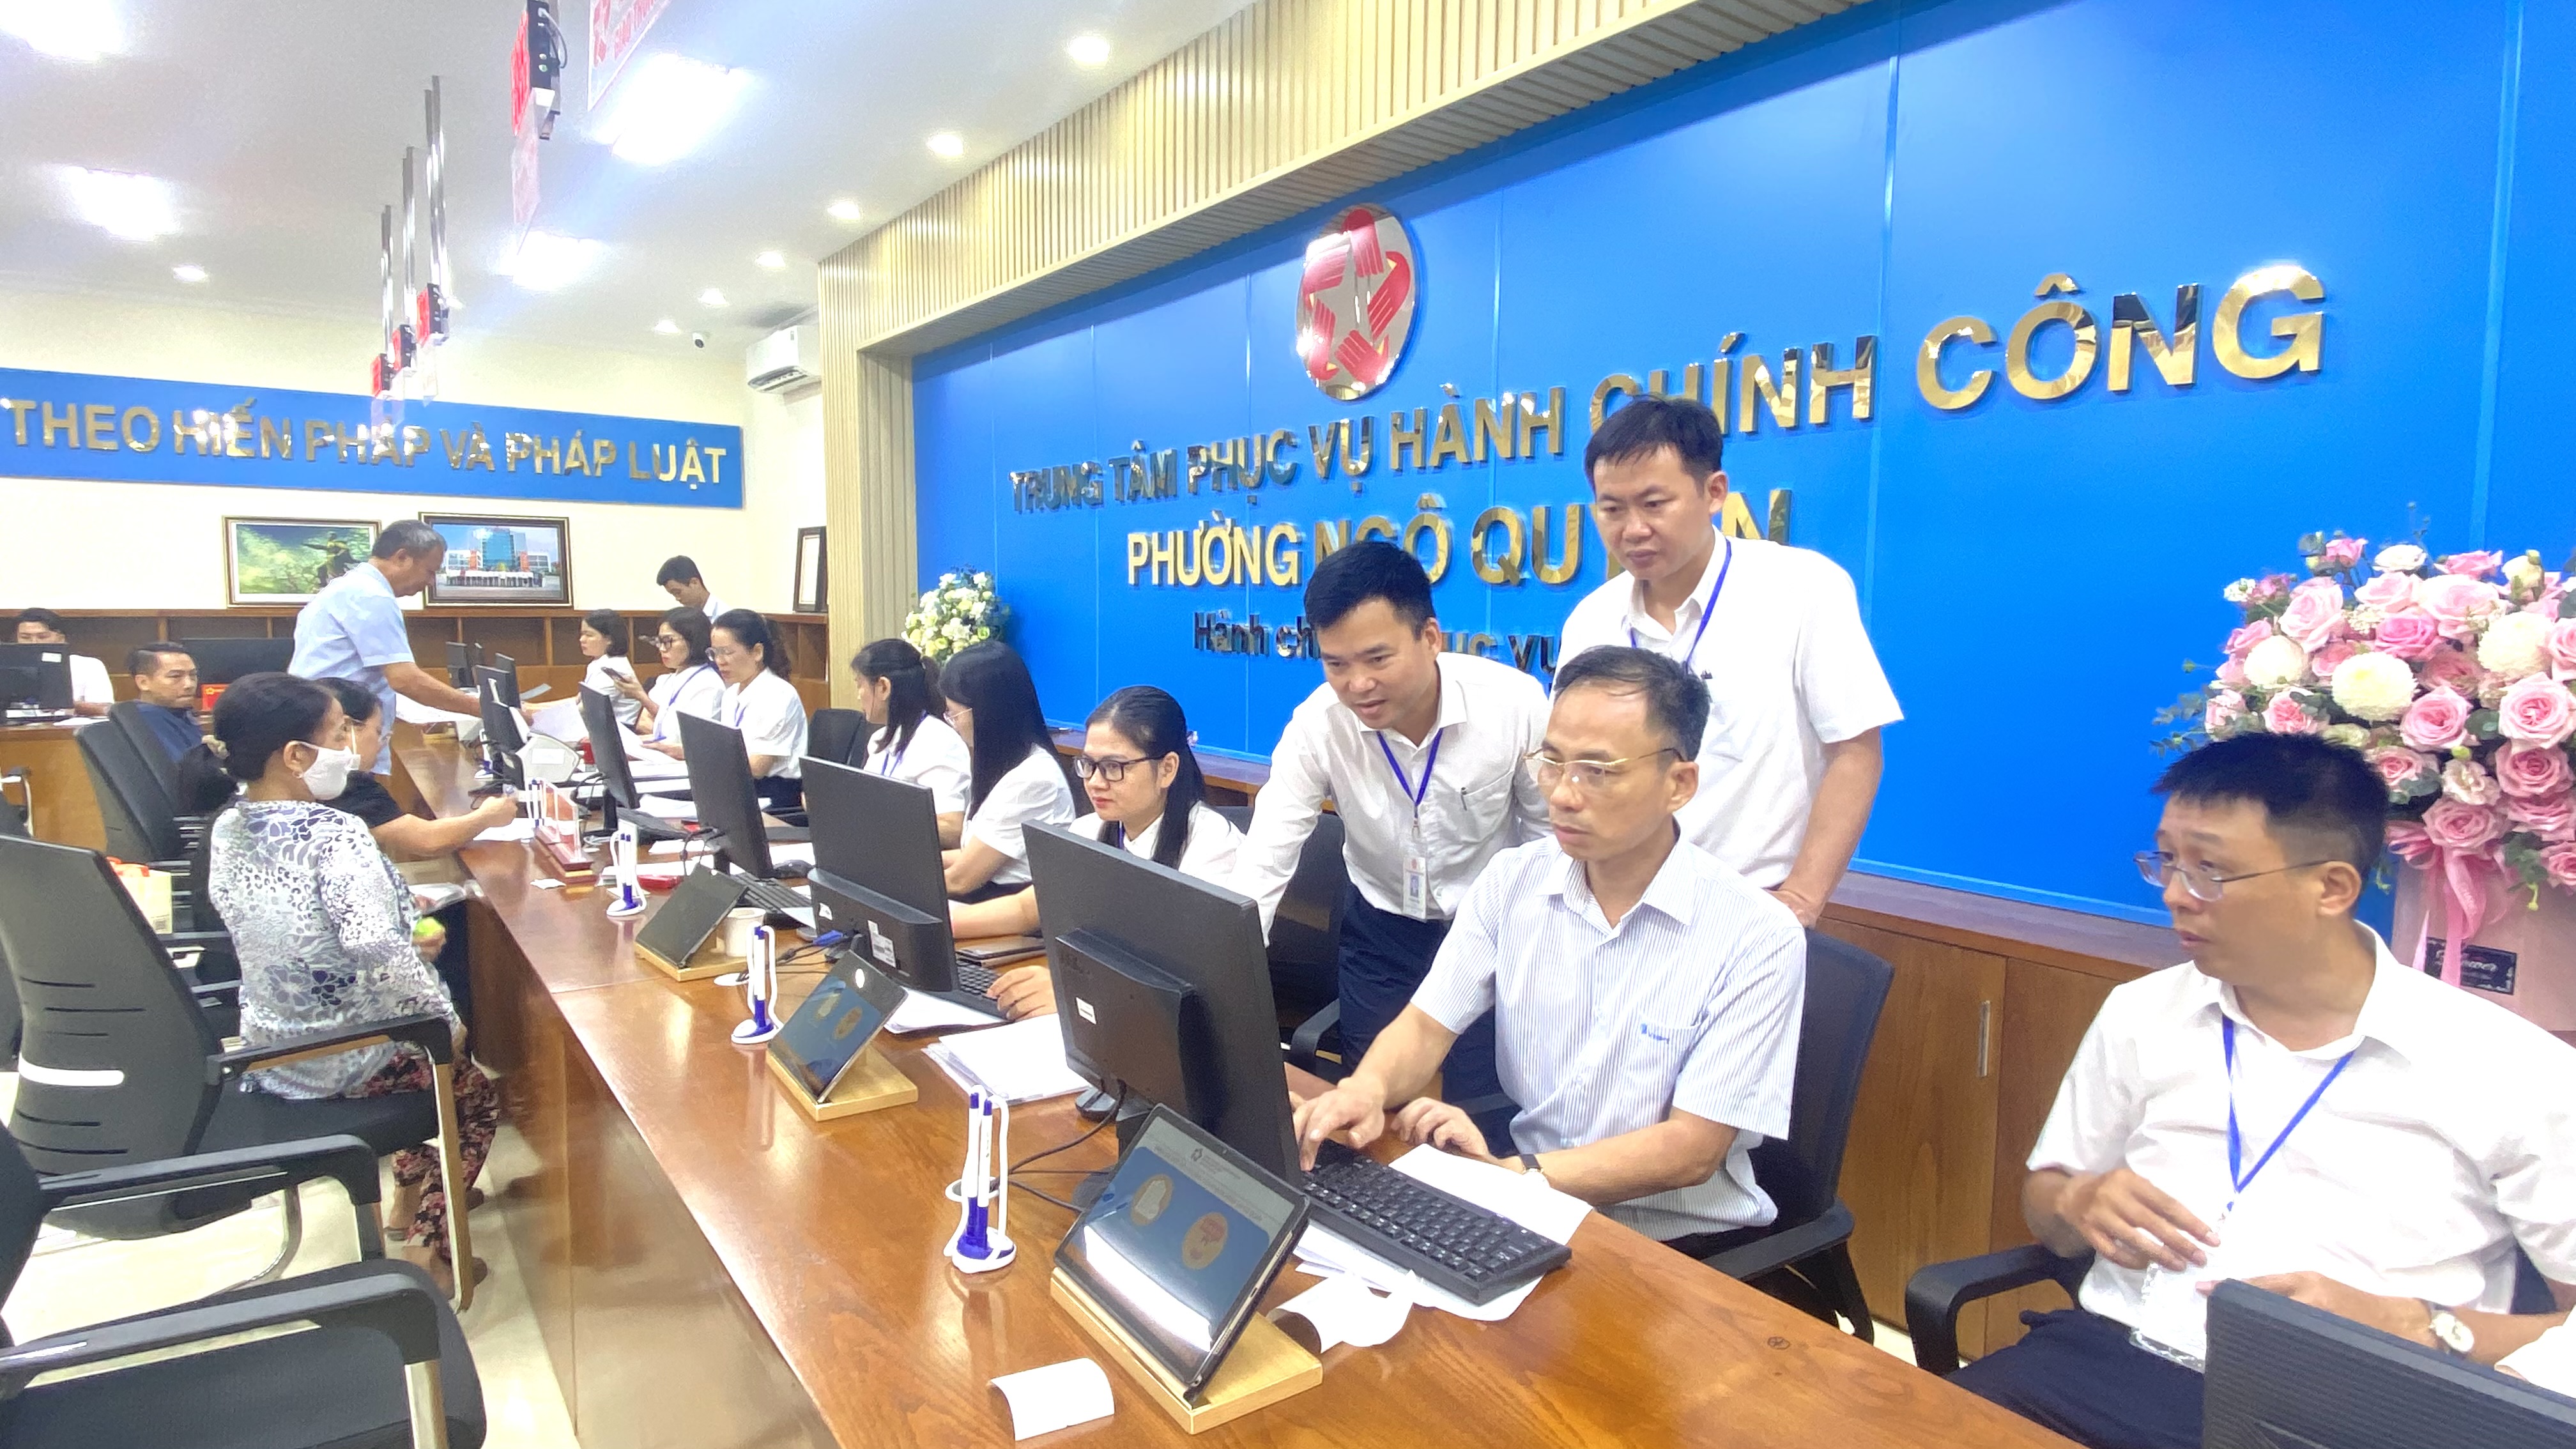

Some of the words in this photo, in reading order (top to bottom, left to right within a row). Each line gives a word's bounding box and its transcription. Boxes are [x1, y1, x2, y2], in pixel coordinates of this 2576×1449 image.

[1009, 461, 1104, 512] TRUNG
[1108, 440, 1178, 503] TÂM
[1187, 429, 1298, 505] PHỤC
[1308, 415, 1374, 493] VỤ
[1390, 383, 1566, 471] HÀNH
[1917, 264, 2324, 410] CÔNG
[3, 399, 161, 453] THEO
[173, 397, 293, 460] HIẾN
[440, 422, 495, 471] VÀ
[505, 429, 618, 477] PHÁP
[628, 438, 727, 490] LUẬT
[1127, 509, 1302, 586] PHƯỜNG
[1193, 609, 1271, 657] Hành
